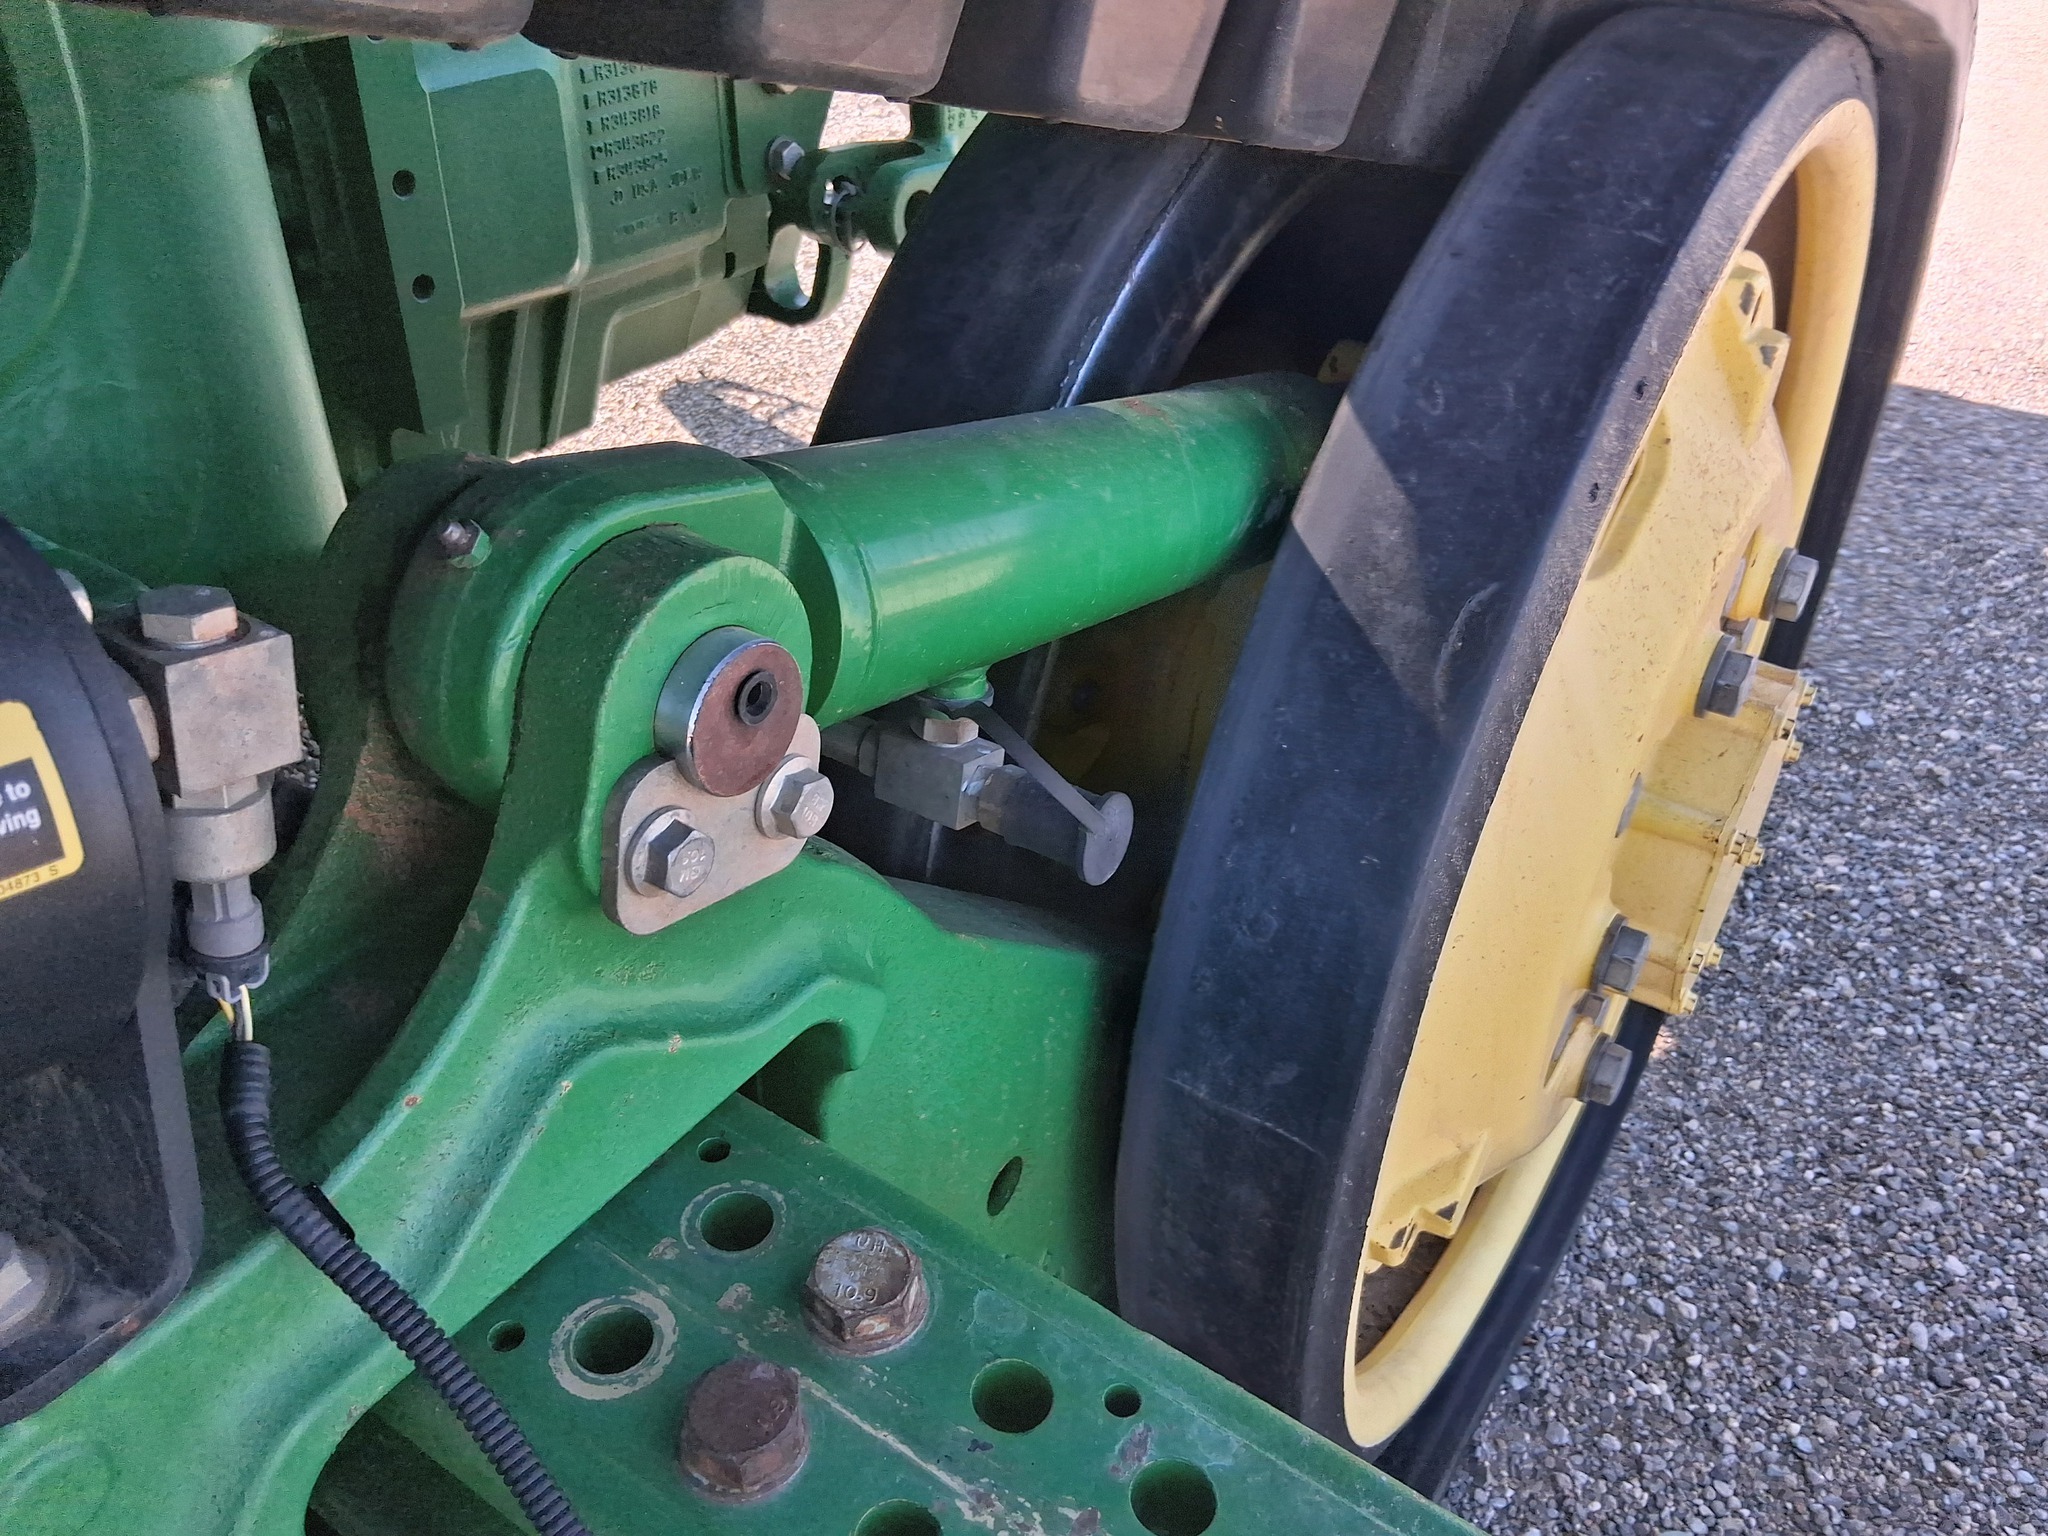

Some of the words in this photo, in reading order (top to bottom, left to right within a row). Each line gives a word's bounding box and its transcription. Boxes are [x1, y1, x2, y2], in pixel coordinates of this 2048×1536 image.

[5, 781, 31, 801] to
[49, 864, 59, 877] S
[834, 1283, 878, 1305] 10.9
